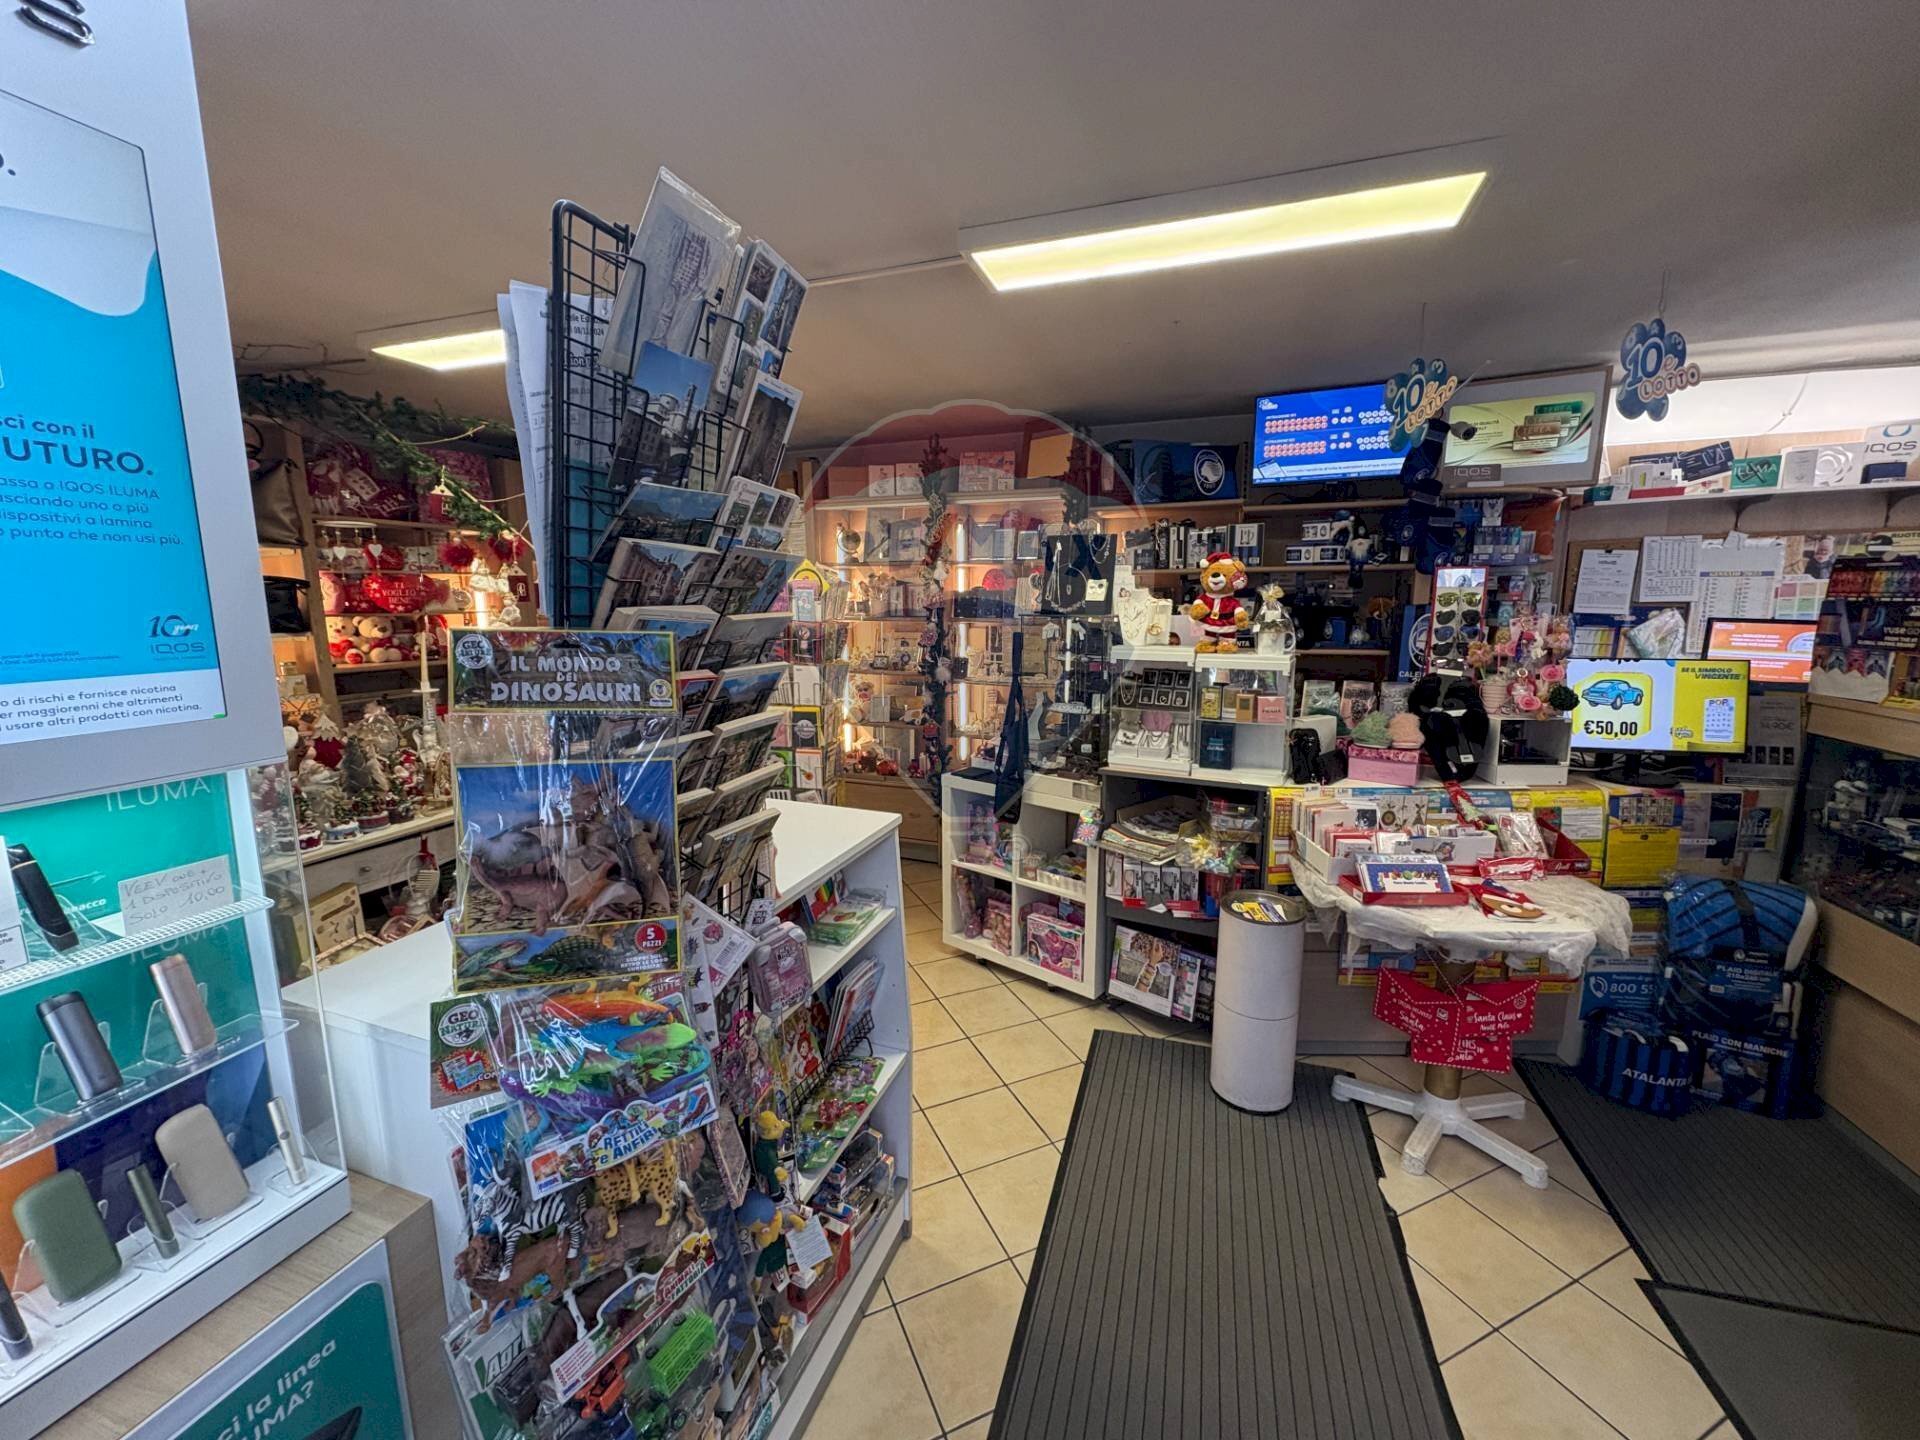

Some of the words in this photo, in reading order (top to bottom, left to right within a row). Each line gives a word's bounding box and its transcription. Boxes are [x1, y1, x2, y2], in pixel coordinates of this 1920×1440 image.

[1625, 336, 1665, 391] 10
[1638, 363, 1701, 403] LOTTO
[1392, 374, 1426, 430] 10
[1404, 376, 1458, 434] LOTTO
[32, 420, 77, 437] con
[82, 424, 95, 439] il
[1864, 440, 1918, 454] IQOS
[1454, 466, 1491, 477] IQOS
[60, 480, 104, 495] IQOS
[110, 485, 161, 500] ILUMA
[80, 501, 109, 511] uno
[127, 502, 149, 515] più
[101, 515, 153, 528] lamina
[10, 527, 64, 540] punta
[69, 530, 98, 541] che
[103, 534, 131, 543] non
[135, 534, 156, 544] usi
[149, 614, 191, 638] 10
[152, 642, 206, 654] IQOS
[510, 656, 531, 673] IL
[537, 655, 622, 673] MONDO
[556, 672, 578, 682] DEI
[13, 696, 26, 706] di
[29, 693, 65, 705] rischi
[67, 693, 76, 701] e
[78, 689, 128, 701] fornisce
[130, 684, 177, 695] nicotina
[491, 682, 642, 702] DINOSAURI
[18, 701, 99, 720] maggiorenni
[102, 698, 125, 710] che
[126, 693, 183, 707] altrimenti
[6, 720, 44, 731] usare
[48, 715, 76, 727] altri
[79, 710, 130, 726] prodotti
[132, 708, 154, 718] con
[155, 704, 203, 716] nicotina.
[1584, 720, 1638, 738] €50,00
[106, 777, 212, 812] ILUMA
[646, 927, 656, 940] 5
[642, 940, 662, 948] PEZZI
[1609, 983, 1637, 993] 800
[448, 1009, 480, 1025] GEO
[1399, 1011, 1426, 1032] Santa
[1473, 1012, 1497, 1022] Santa
[1497, 1011, 1517, 1022] Claus
[1721, 1037, 1743, 1048] CON
[1743, 1042, 1790, 1058] MANICHE
[600, 1154, 609, 1164] e
[246, 1394, 272, 1422] la
[277, 1339, 337, 1396] linea
